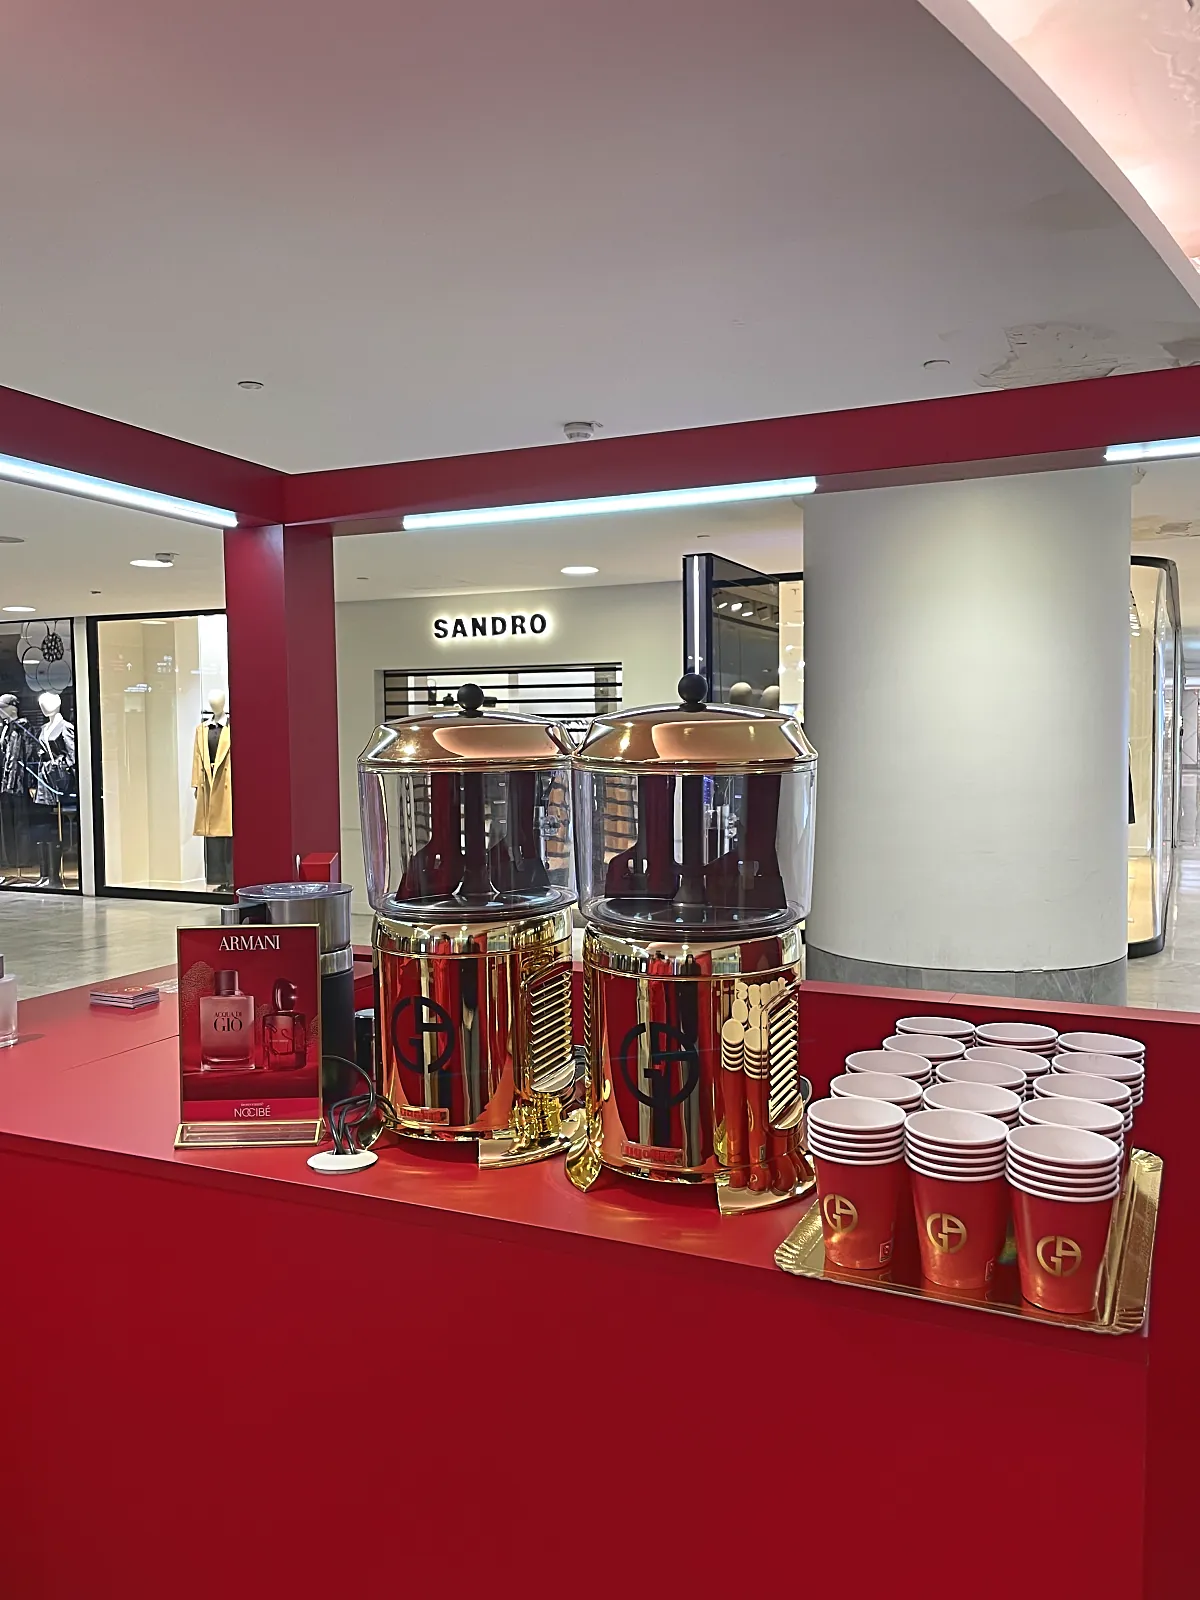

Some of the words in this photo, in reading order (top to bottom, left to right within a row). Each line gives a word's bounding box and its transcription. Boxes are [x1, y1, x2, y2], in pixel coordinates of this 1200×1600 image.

[433, 613, 547, 639] SANDRO
[218, 934, 281, 951] ARMANI
[233, 1104, 271, 1118] NOCIBÉ
